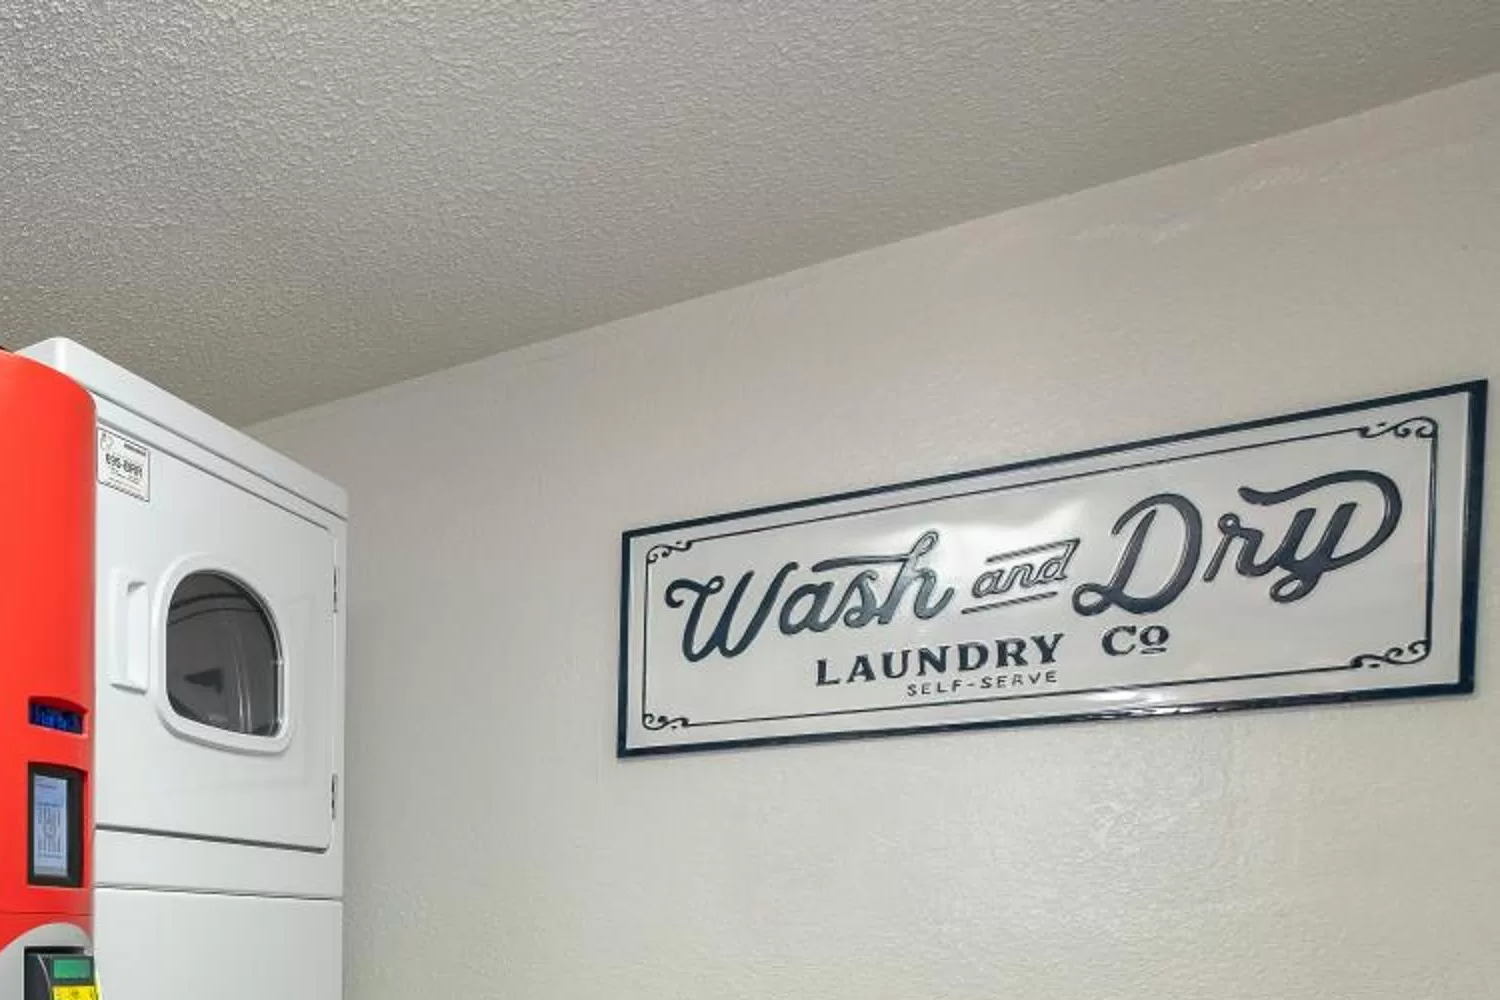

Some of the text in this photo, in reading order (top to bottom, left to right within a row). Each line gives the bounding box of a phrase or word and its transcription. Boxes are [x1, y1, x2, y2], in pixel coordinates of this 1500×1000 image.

[665, 468, 1403, 662] Wash and Dry
[814, 632, 1067, 688] LAUNDRY
[906, 670, 1060, 698] SELF-SERVE
